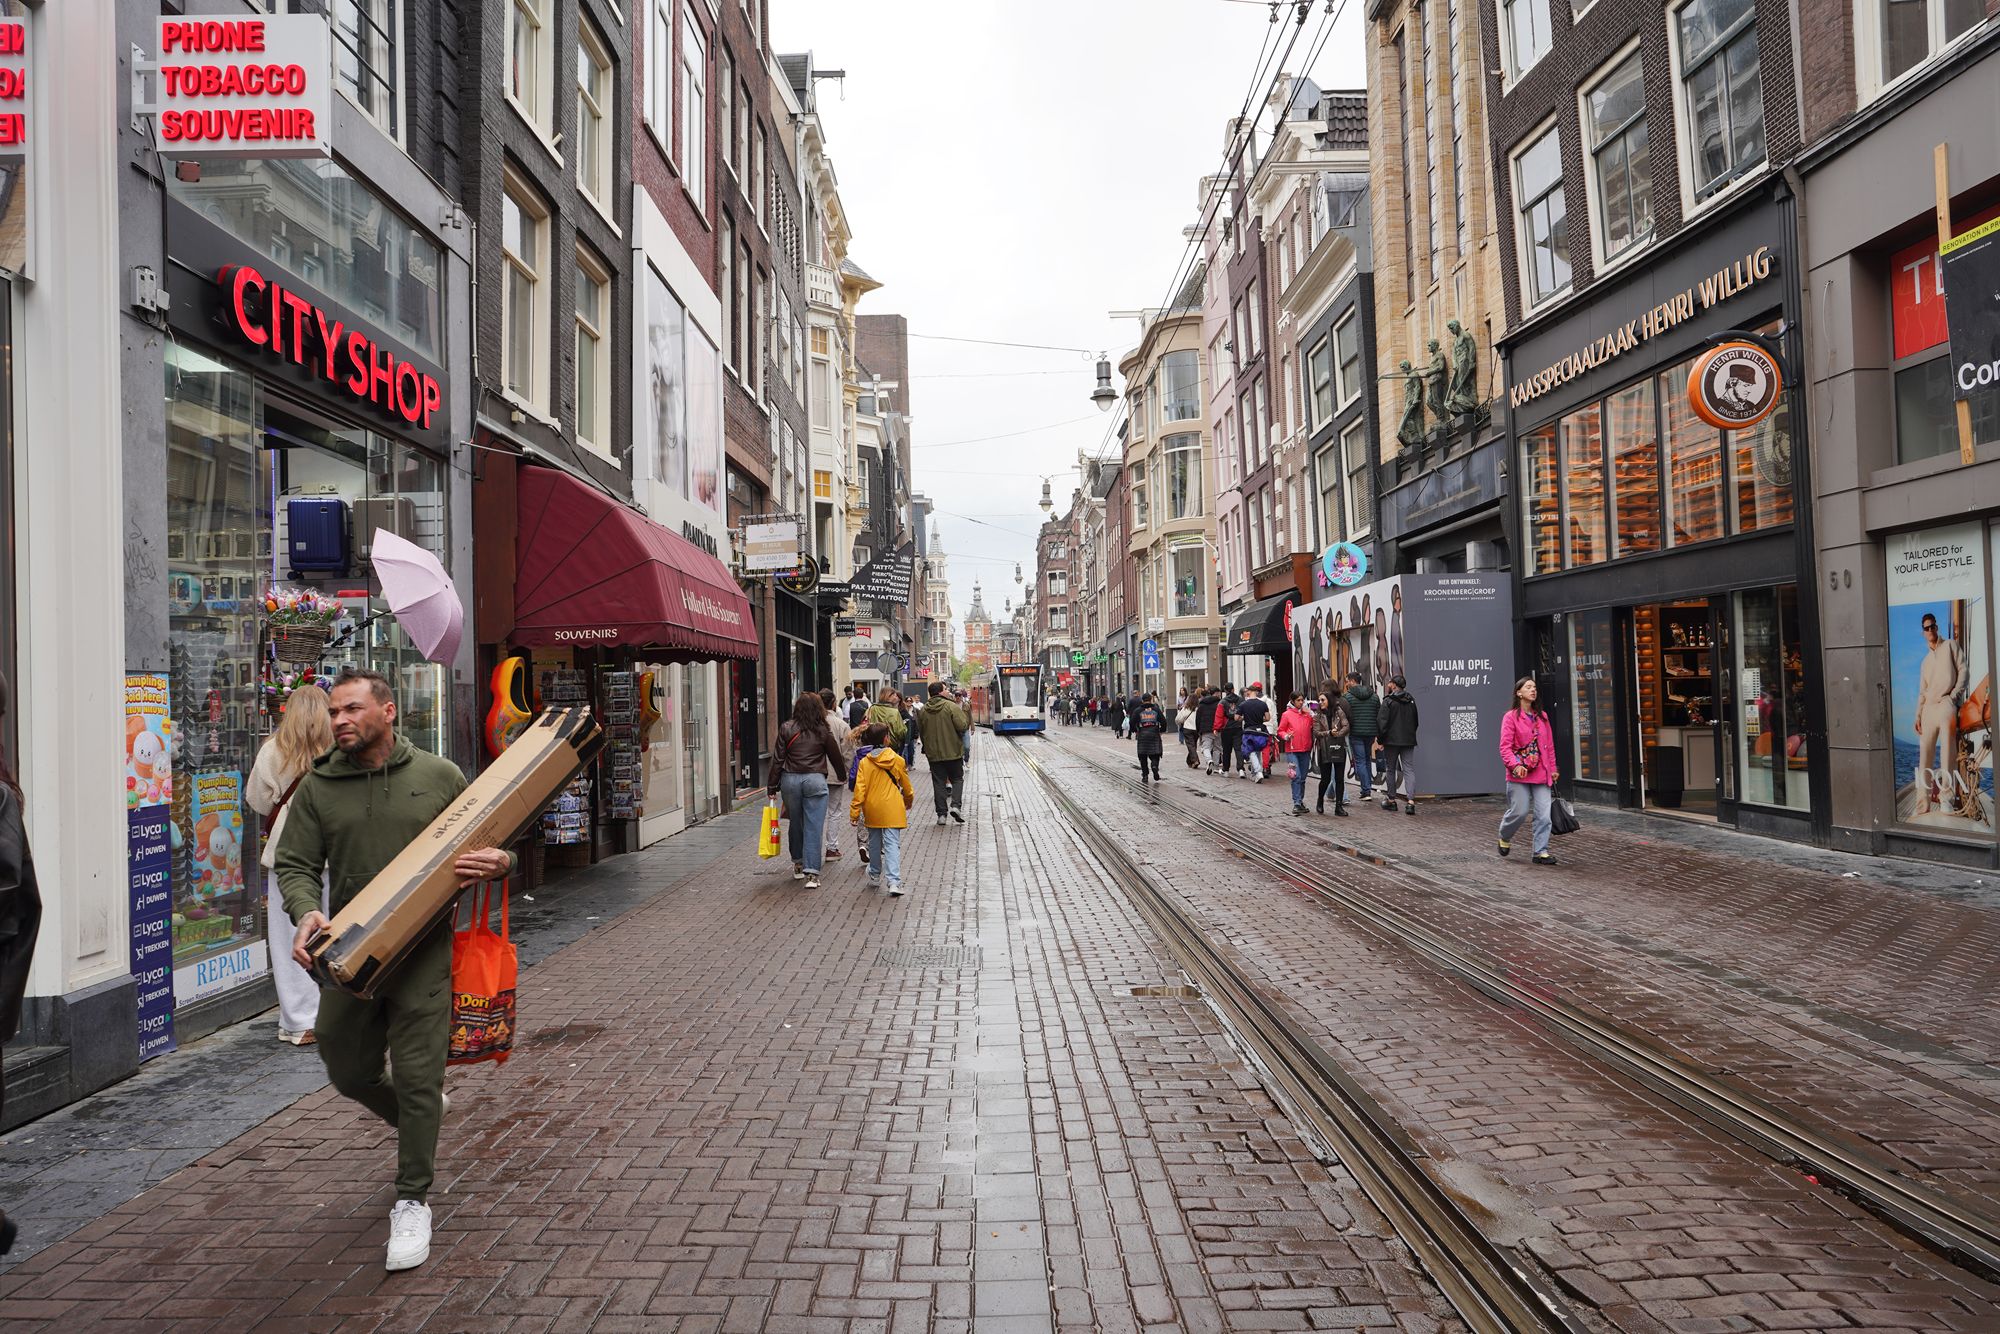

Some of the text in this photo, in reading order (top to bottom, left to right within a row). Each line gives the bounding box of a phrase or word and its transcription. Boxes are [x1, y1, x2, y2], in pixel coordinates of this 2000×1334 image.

[162, 21, 265, 53] PHONE
[161, 64, 306, 97] TOBACCO
[162, 109, 315, 142] SOUVENIR
[1943, 230, 1981, 252] RENOVATION
[1510, 246, 1772, 409] KAASSPECIAALZAAK HENRI WILLIG
[233, 265, 441, 430] CITY SHOP
[1710, 350, 1771, 374] HENRI WILLIG
[1718, 406, 1757, 418] SINCE 1974
[683, 519, 718, 559] PANDORA
[1904, 545, 1963, 561] TAILORED for
[1894, 555, 1975, 574] YOUR LIFESTYLE.
[1830, 568, 1851, 590] 50
[555, 629, 618, 640] SOUVENIRS
[1186, 650, 1193, 658] M
[1431, 659, 1492, 671] JULIAN OPIE,
[125, 674, 167, 691] umplings
[1434, 674, 1490, 688] The Angel 1.
[142, 690, 161, 704] Here
[197, 775, 237, 791] Dumplings
[1914, 766, 1969, 797] ICON
[200, 790, 217, 804] Sold
[217, 789, 233, 801] Here
[432, 798, 478, 839] aktive
[141, 824, 161, 838] Lyca
[145, 845, 166, 856] DUWEN
[142, 872, 162, 887] Lyca
[146, 892, 167, 904] DUWEN
[240, 914, 254, 925] FREE
[142, 920, 163, 936] Lyca
[144, 940, 169, 954] TREKKEN
[142, 967, 164, 984] Lyca
[196, 948, 250, 987] REPAIR
[239, 974, 251, 982] Ready
[144, 986, 169, 1002] TREKKEN
[179, 985, 224, 1006] Screen Replacement
[143, 1014, 164, 1032] Lyca
[147, 1034, 169, 1049] DUWEN
